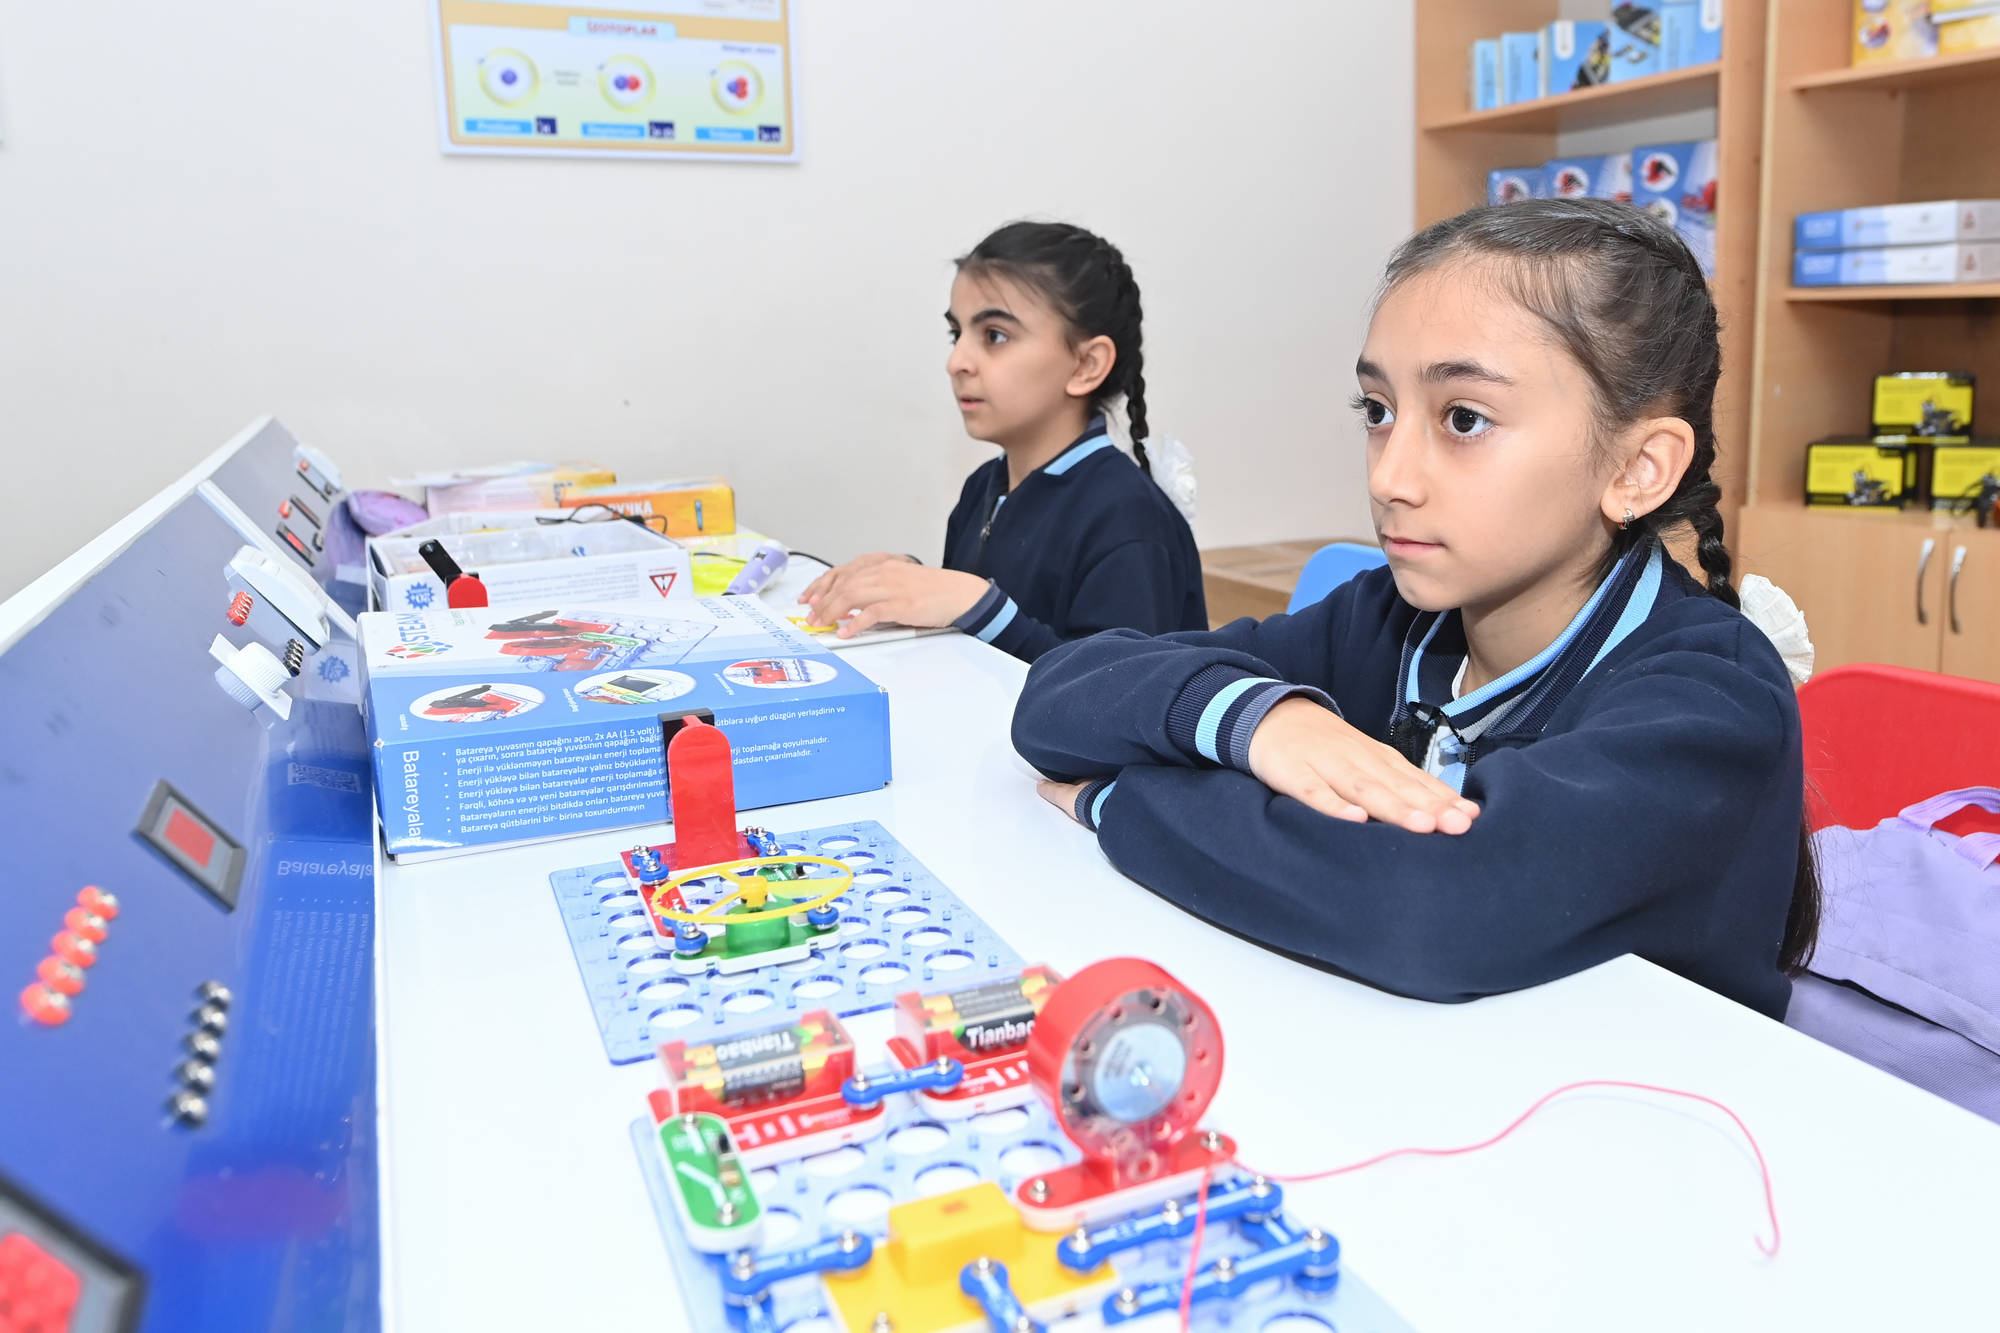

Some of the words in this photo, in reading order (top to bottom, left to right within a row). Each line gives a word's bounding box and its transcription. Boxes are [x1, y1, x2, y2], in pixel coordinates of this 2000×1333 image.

[456, 747, 493, 756] Batareya
[770, 712, 796, 721] düzgün
[501, 751, 524, 759] sonra
[458, 766, 482, 776] Enerji
[604, 749, 627, 758] enerji
[458, 778, 483, 788] Enerji
[459, 790, 483, 799] Enerji
[591, 774, 614, 783] enerji
[540, 792, 557, 802] yeni
[461, 824, 498, 833] Batareya
